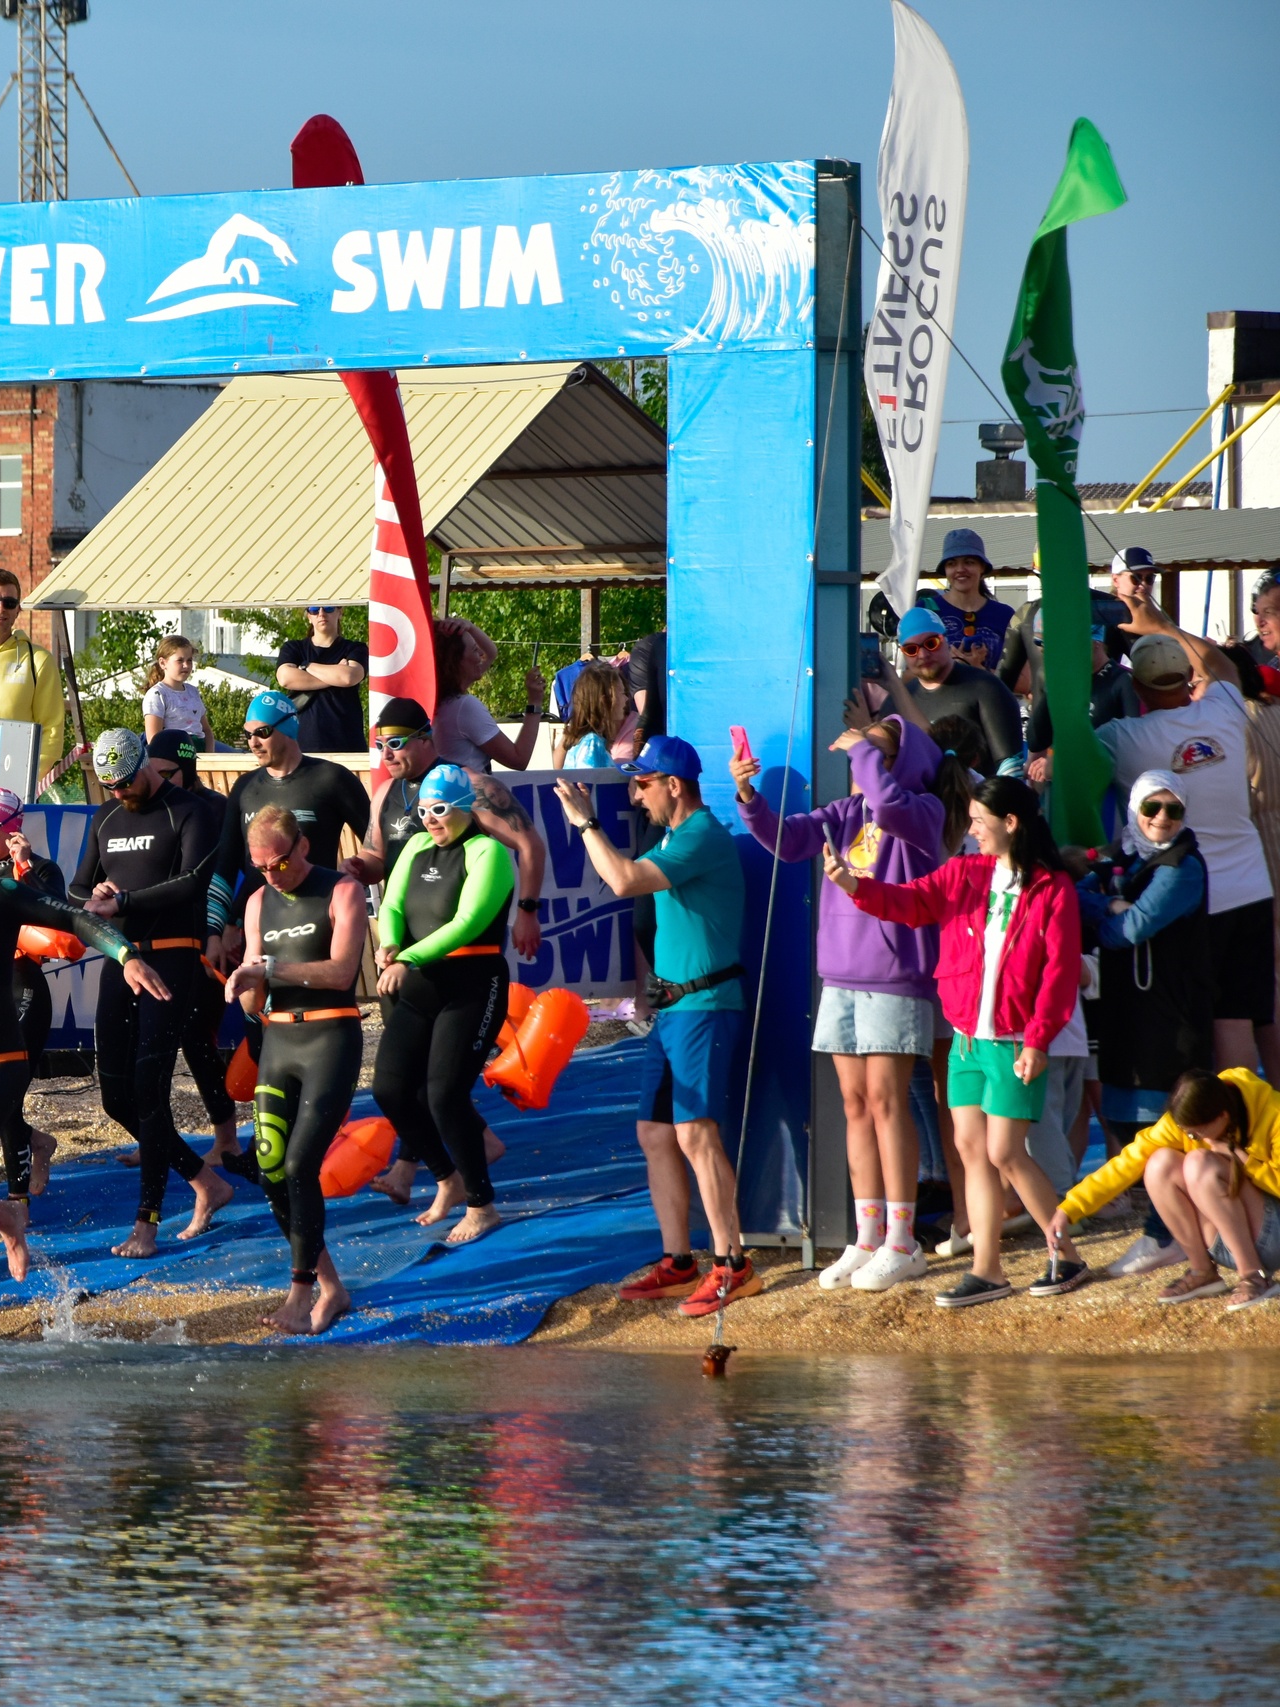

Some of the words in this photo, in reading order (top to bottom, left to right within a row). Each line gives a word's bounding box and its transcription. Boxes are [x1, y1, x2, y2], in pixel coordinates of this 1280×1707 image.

[331, 222, 563, 313] SWIM
[38, 896, 84, 914] Aqua
[264, 923, 316, 942] orca
[478, 976, 499, 1037] SCORPENA
[18, 1144, 31, 1176] TYR
